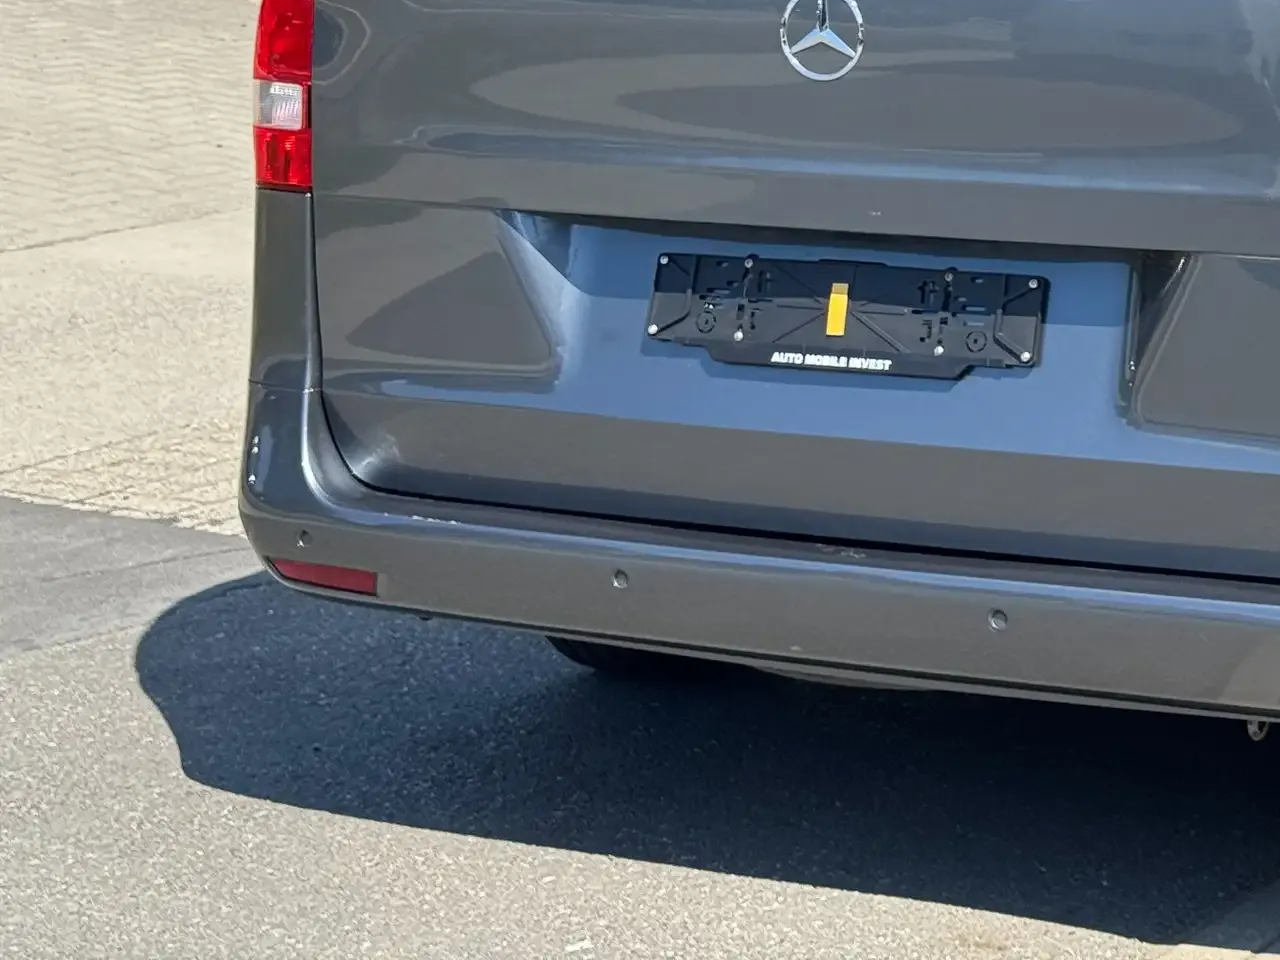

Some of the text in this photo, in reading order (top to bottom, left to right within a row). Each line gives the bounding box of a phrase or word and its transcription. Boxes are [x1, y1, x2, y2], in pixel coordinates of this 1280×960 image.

[770, 351, 893, 371] AUTO MOBILE INVEST
